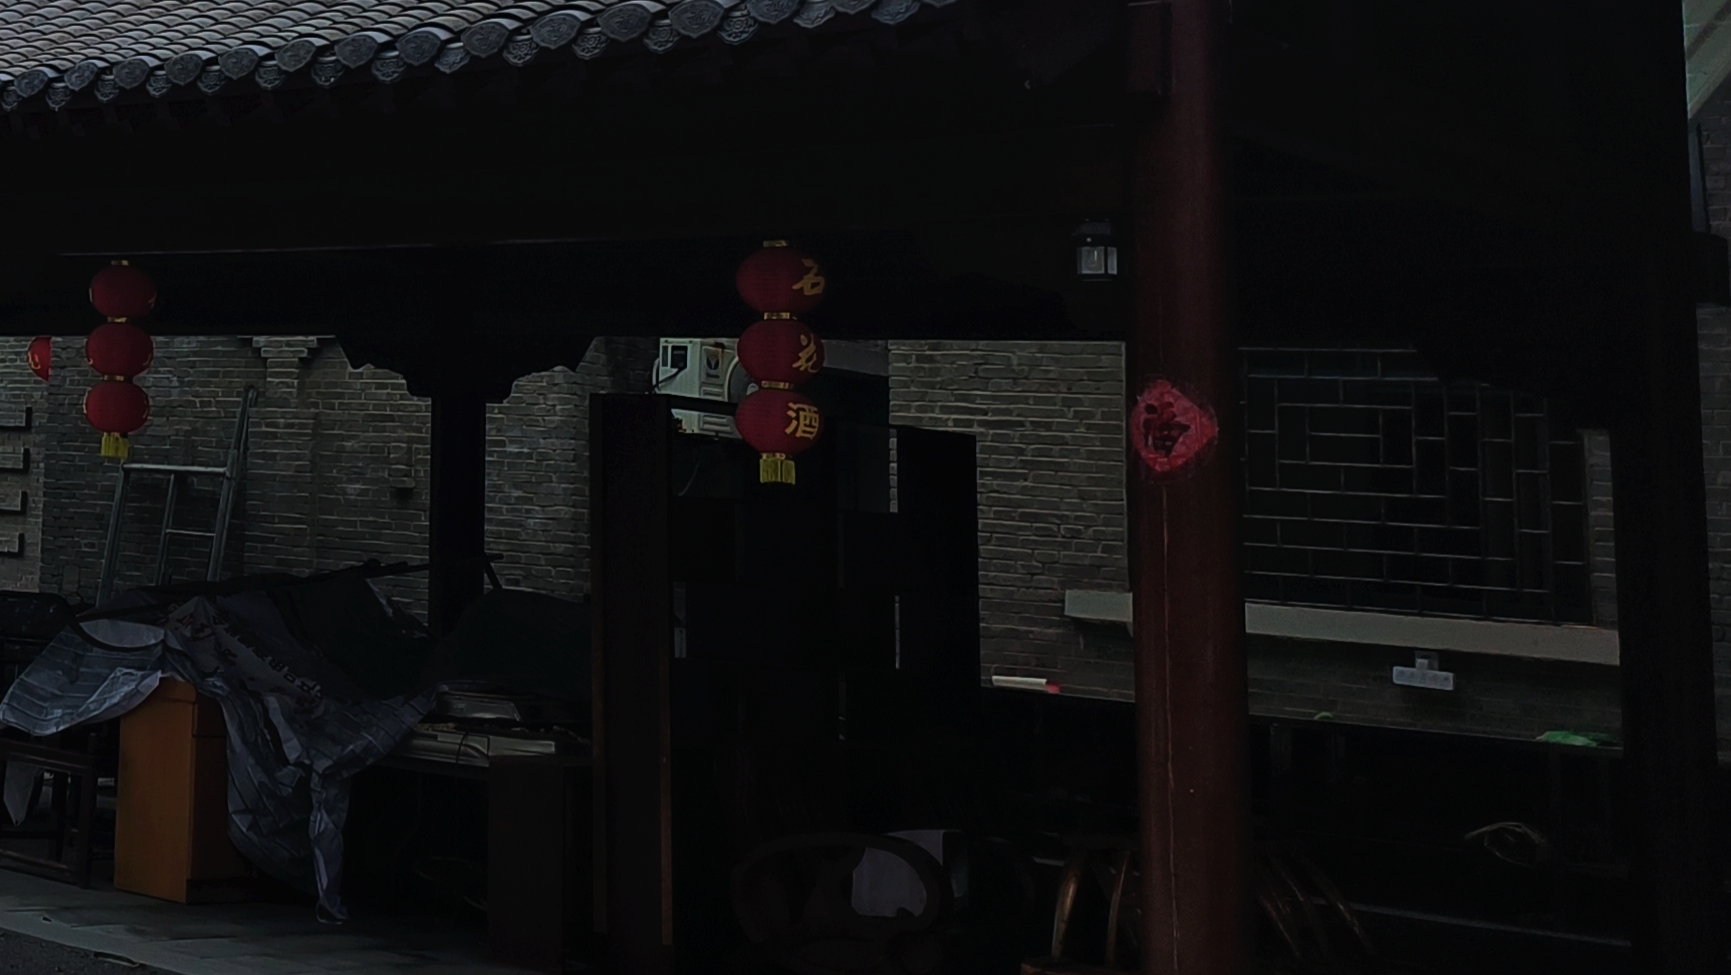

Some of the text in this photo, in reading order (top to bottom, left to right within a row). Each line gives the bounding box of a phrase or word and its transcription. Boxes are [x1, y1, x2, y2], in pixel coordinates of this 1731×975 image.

[784, 258, 826, 441] 石花酒
[1142, 402, 1191, 459] 福
